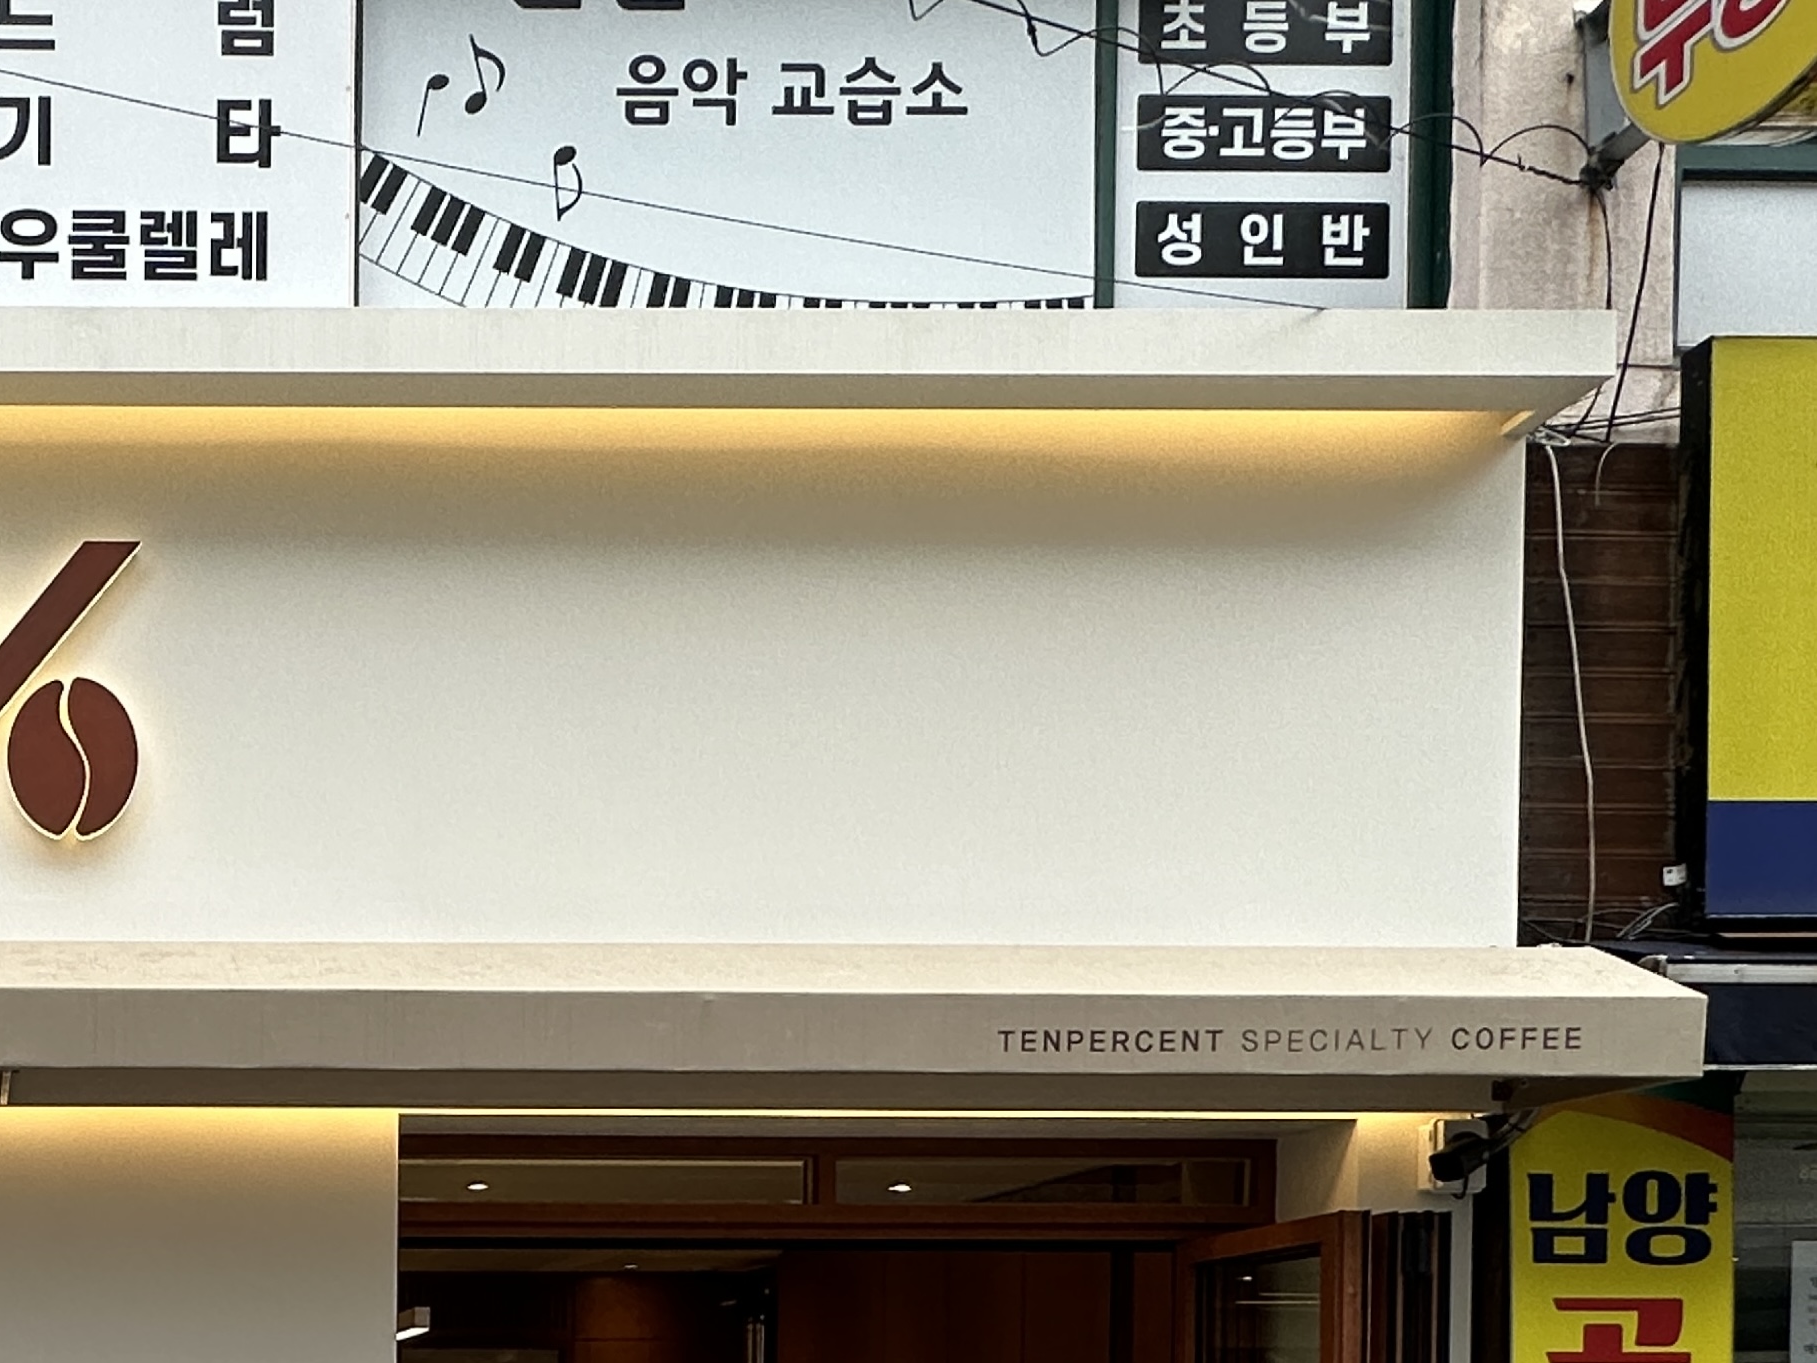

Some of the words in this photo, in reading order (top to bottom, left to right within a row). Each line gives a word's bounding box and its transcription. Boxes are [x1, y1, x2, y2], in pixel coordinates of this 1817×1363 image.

[616, 54, 748, 126] 음악
[772, 56, 969, 126] 교습소
[997, 1028, 1225, 1053] TENPERCENT
[1241, 1027, 1434, 1052] SPECIALTY
[1450, 1026, 1583, 1051] COFFEE
[1527, 1169, 1718, 1265] 남양
